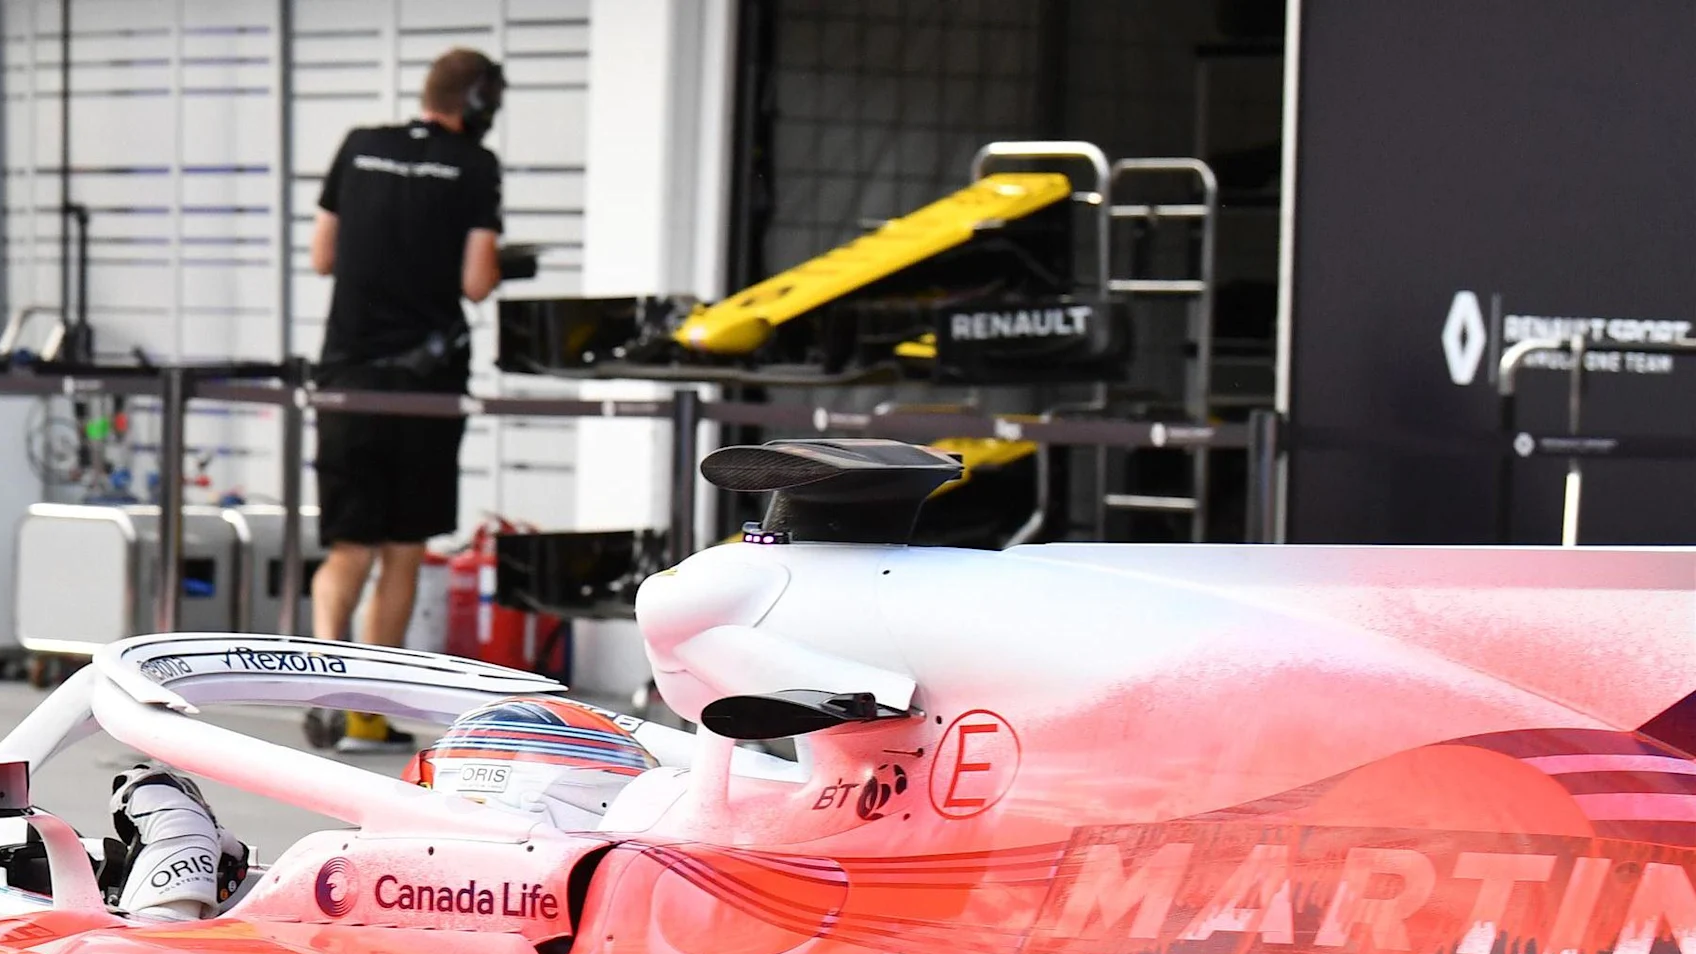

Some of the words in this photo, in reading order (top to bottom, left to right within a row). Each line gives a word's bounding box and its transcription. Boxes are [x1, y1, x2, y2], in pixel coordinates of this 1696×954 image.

[951, 306, 1092, 340] RENAULT
[233, 647, 347, 673] Rexona
[462, 768, 506, 783] ORIS
[944, 724, 998, 808] E
[151, 855, 214, 888] ORIS
[374, 874, 494, 915] Canada
[502, 882, 560, 919] Life
